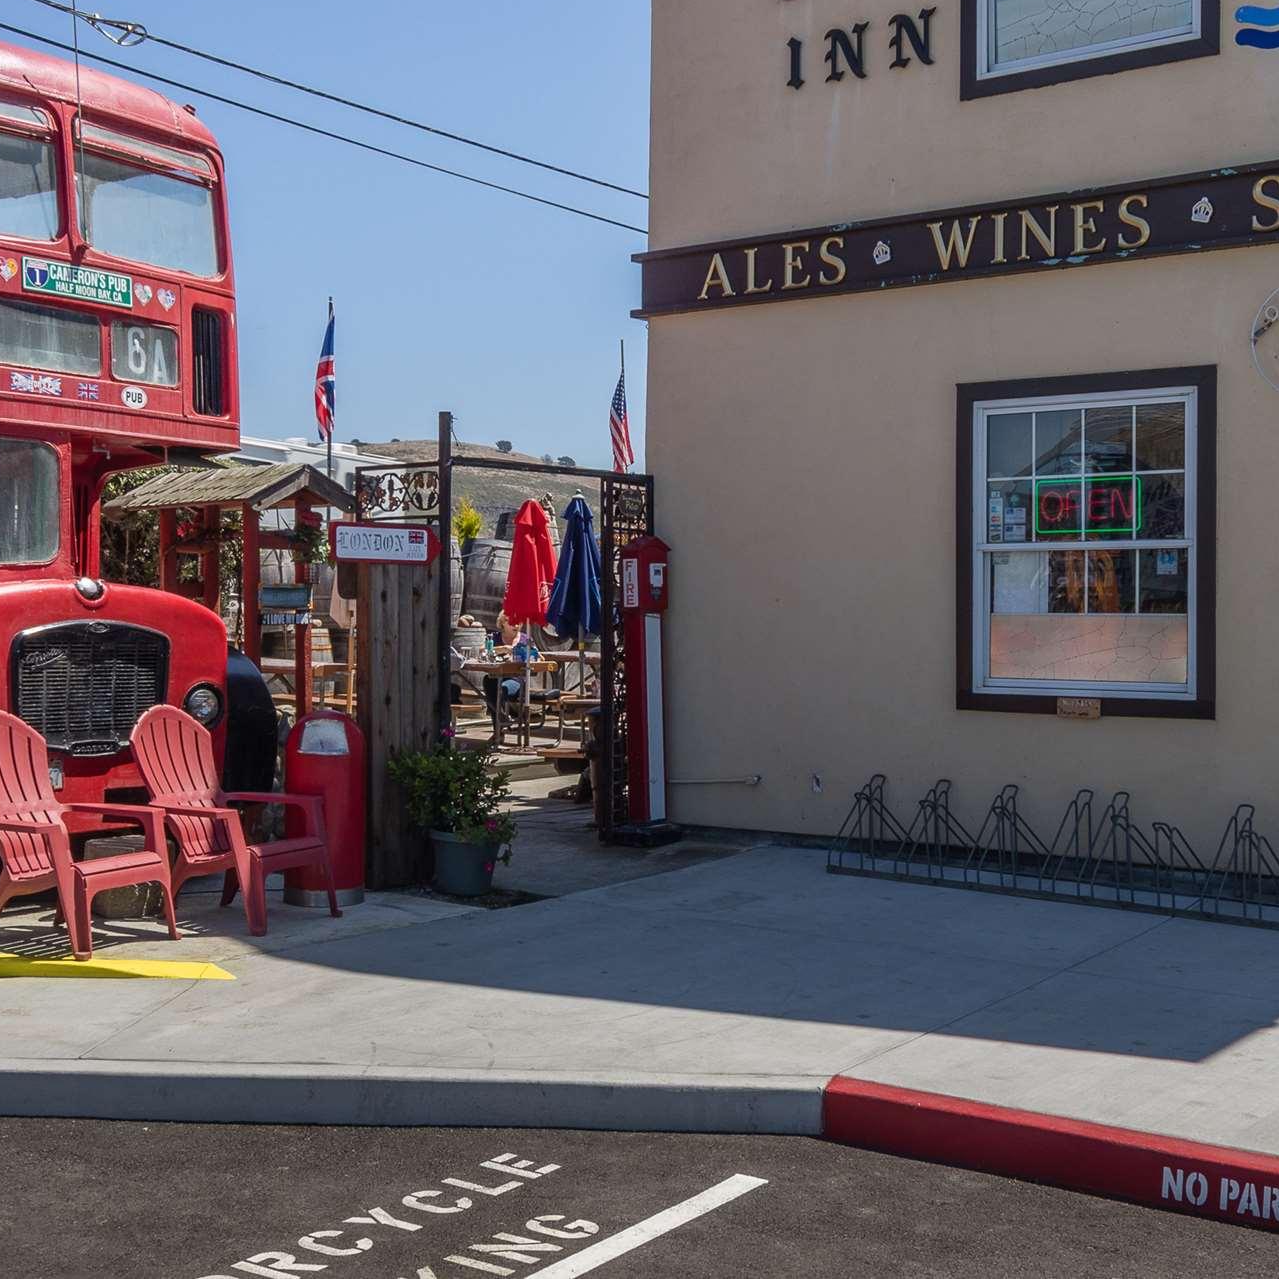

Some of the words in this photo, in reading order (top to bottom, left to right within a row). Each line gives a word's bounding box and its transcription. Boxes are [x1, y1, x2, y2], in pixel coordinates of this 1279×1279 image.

[786, 6, 938, 90] INN
[696, 236, 847, 300] ALES
[927, 194, 1152, 271] WINES
[34, 268, 41, 285] 1
[49, 265, 106, 291] CAMERON'S
[108, 276, 127, 292] PUB
[55, 281, 75, 293] HALF
[76, 284, 96, 298] MOON
[113, 291, 123, 302] CA
[125, 391, 143, 404] PUB
[1040, 488, 1134, 522] OPEN
[337, 530, 406, 552] LONDON
[625, 561, 635, 606] FIRE
[1160, 1166, 1209, 1206] NO
[397, 1214, 600, 1279] ING
